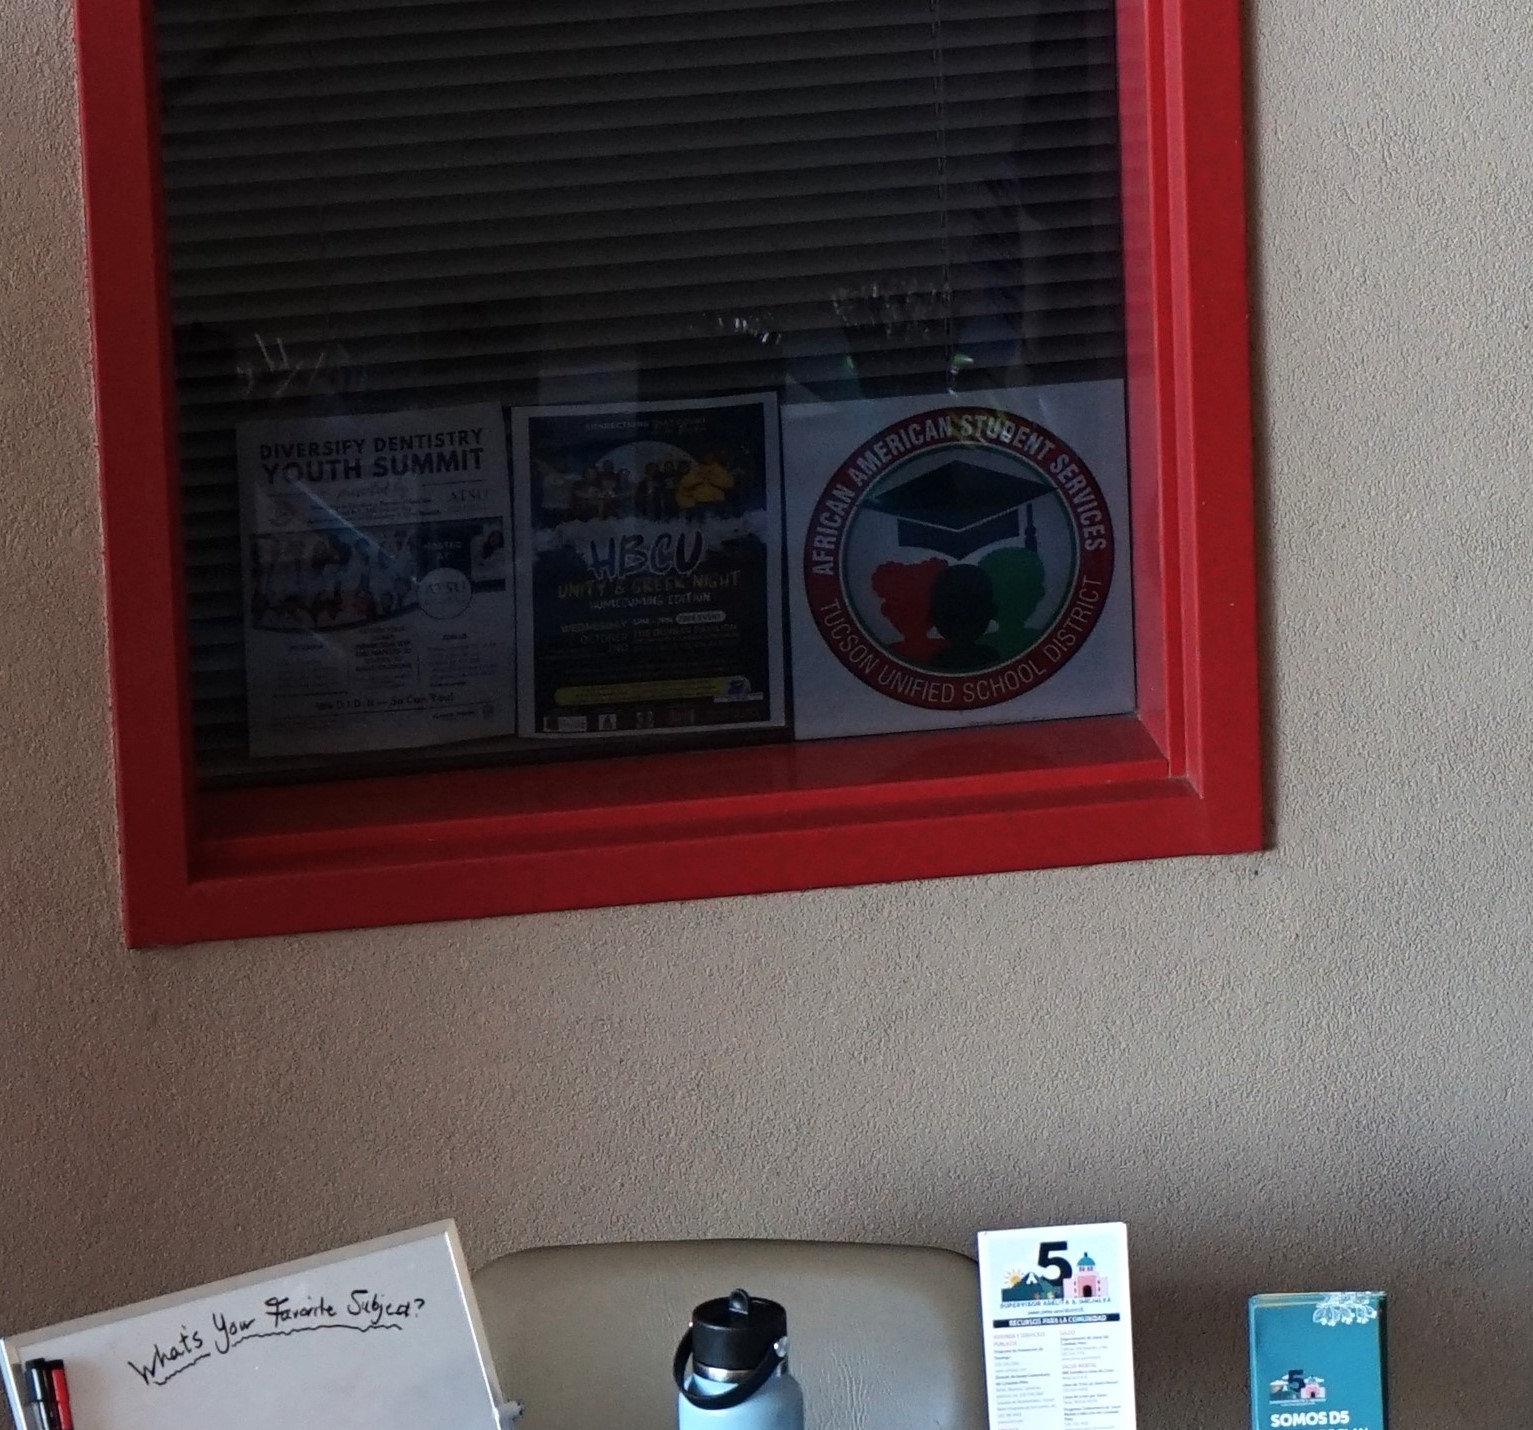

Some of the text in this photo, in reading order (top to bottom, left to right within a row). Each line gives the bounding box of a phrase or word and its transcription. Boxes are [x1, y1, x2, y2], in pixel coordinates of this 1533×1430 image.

[260, 427, 484, 461] DIVERSIFY DENTISTRY
[262, 447, 484, 485] YOUTH SUMMIT
[811, 414, 1107, 575] AFRICAN AMERICAN STUDENT SERVICES
[587, 531, 705, 581] HBCU
[557, 580, 607, 600] UNITY
[692, 568, 742, 590] NIGHT
[820, 574, 1102, 703] TUCSON UNIFIED SCHOOL DISTRICT
[1026, 1272, 1038, 1285] A
[1038, 1240, 1073, 1286] 5
[128, 1289, 426, 1387] What's Your Favorite Subject?
[1008, 1318, 1041, 1327] RECURSOS
[1042, 1317, 1060, 1325] PARA
[1288, 1368, 1306, 1393] 5
[1270, 1410, 1350, 1428] SOMOS D5
